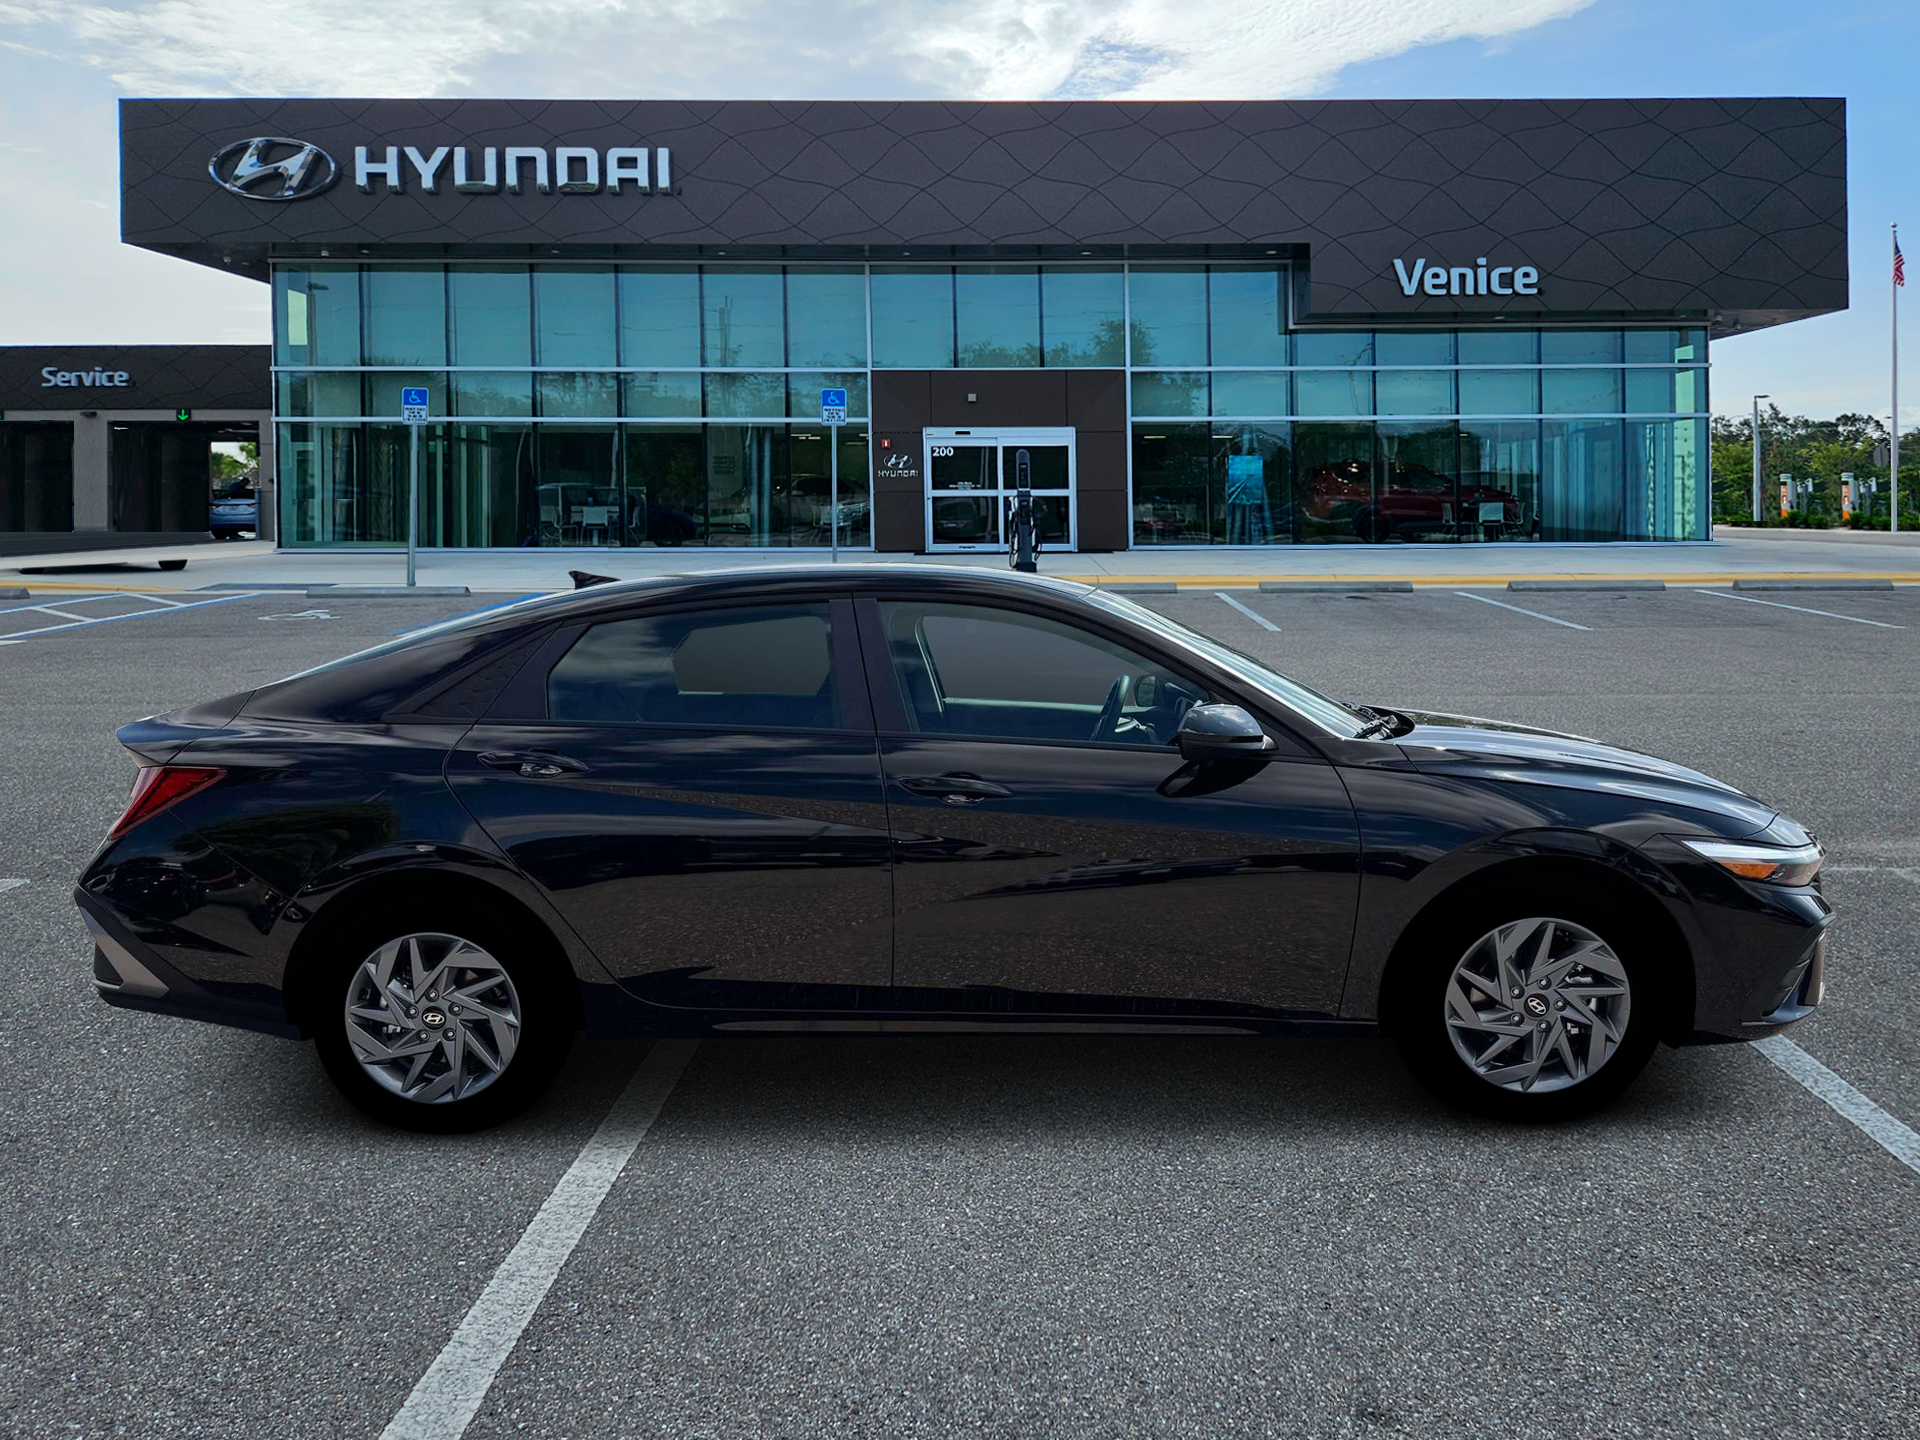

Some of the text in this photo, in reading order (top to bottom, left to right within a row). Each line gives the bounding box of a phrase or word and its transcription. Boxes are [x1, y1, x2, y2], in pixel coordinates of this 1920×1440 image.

[354, 146, 671, 193] HYUNDAI
[1393, 257, 1539, 295] Venice
[41, 366, 129, 387] Service
[932, 447, 954, 457] 200
